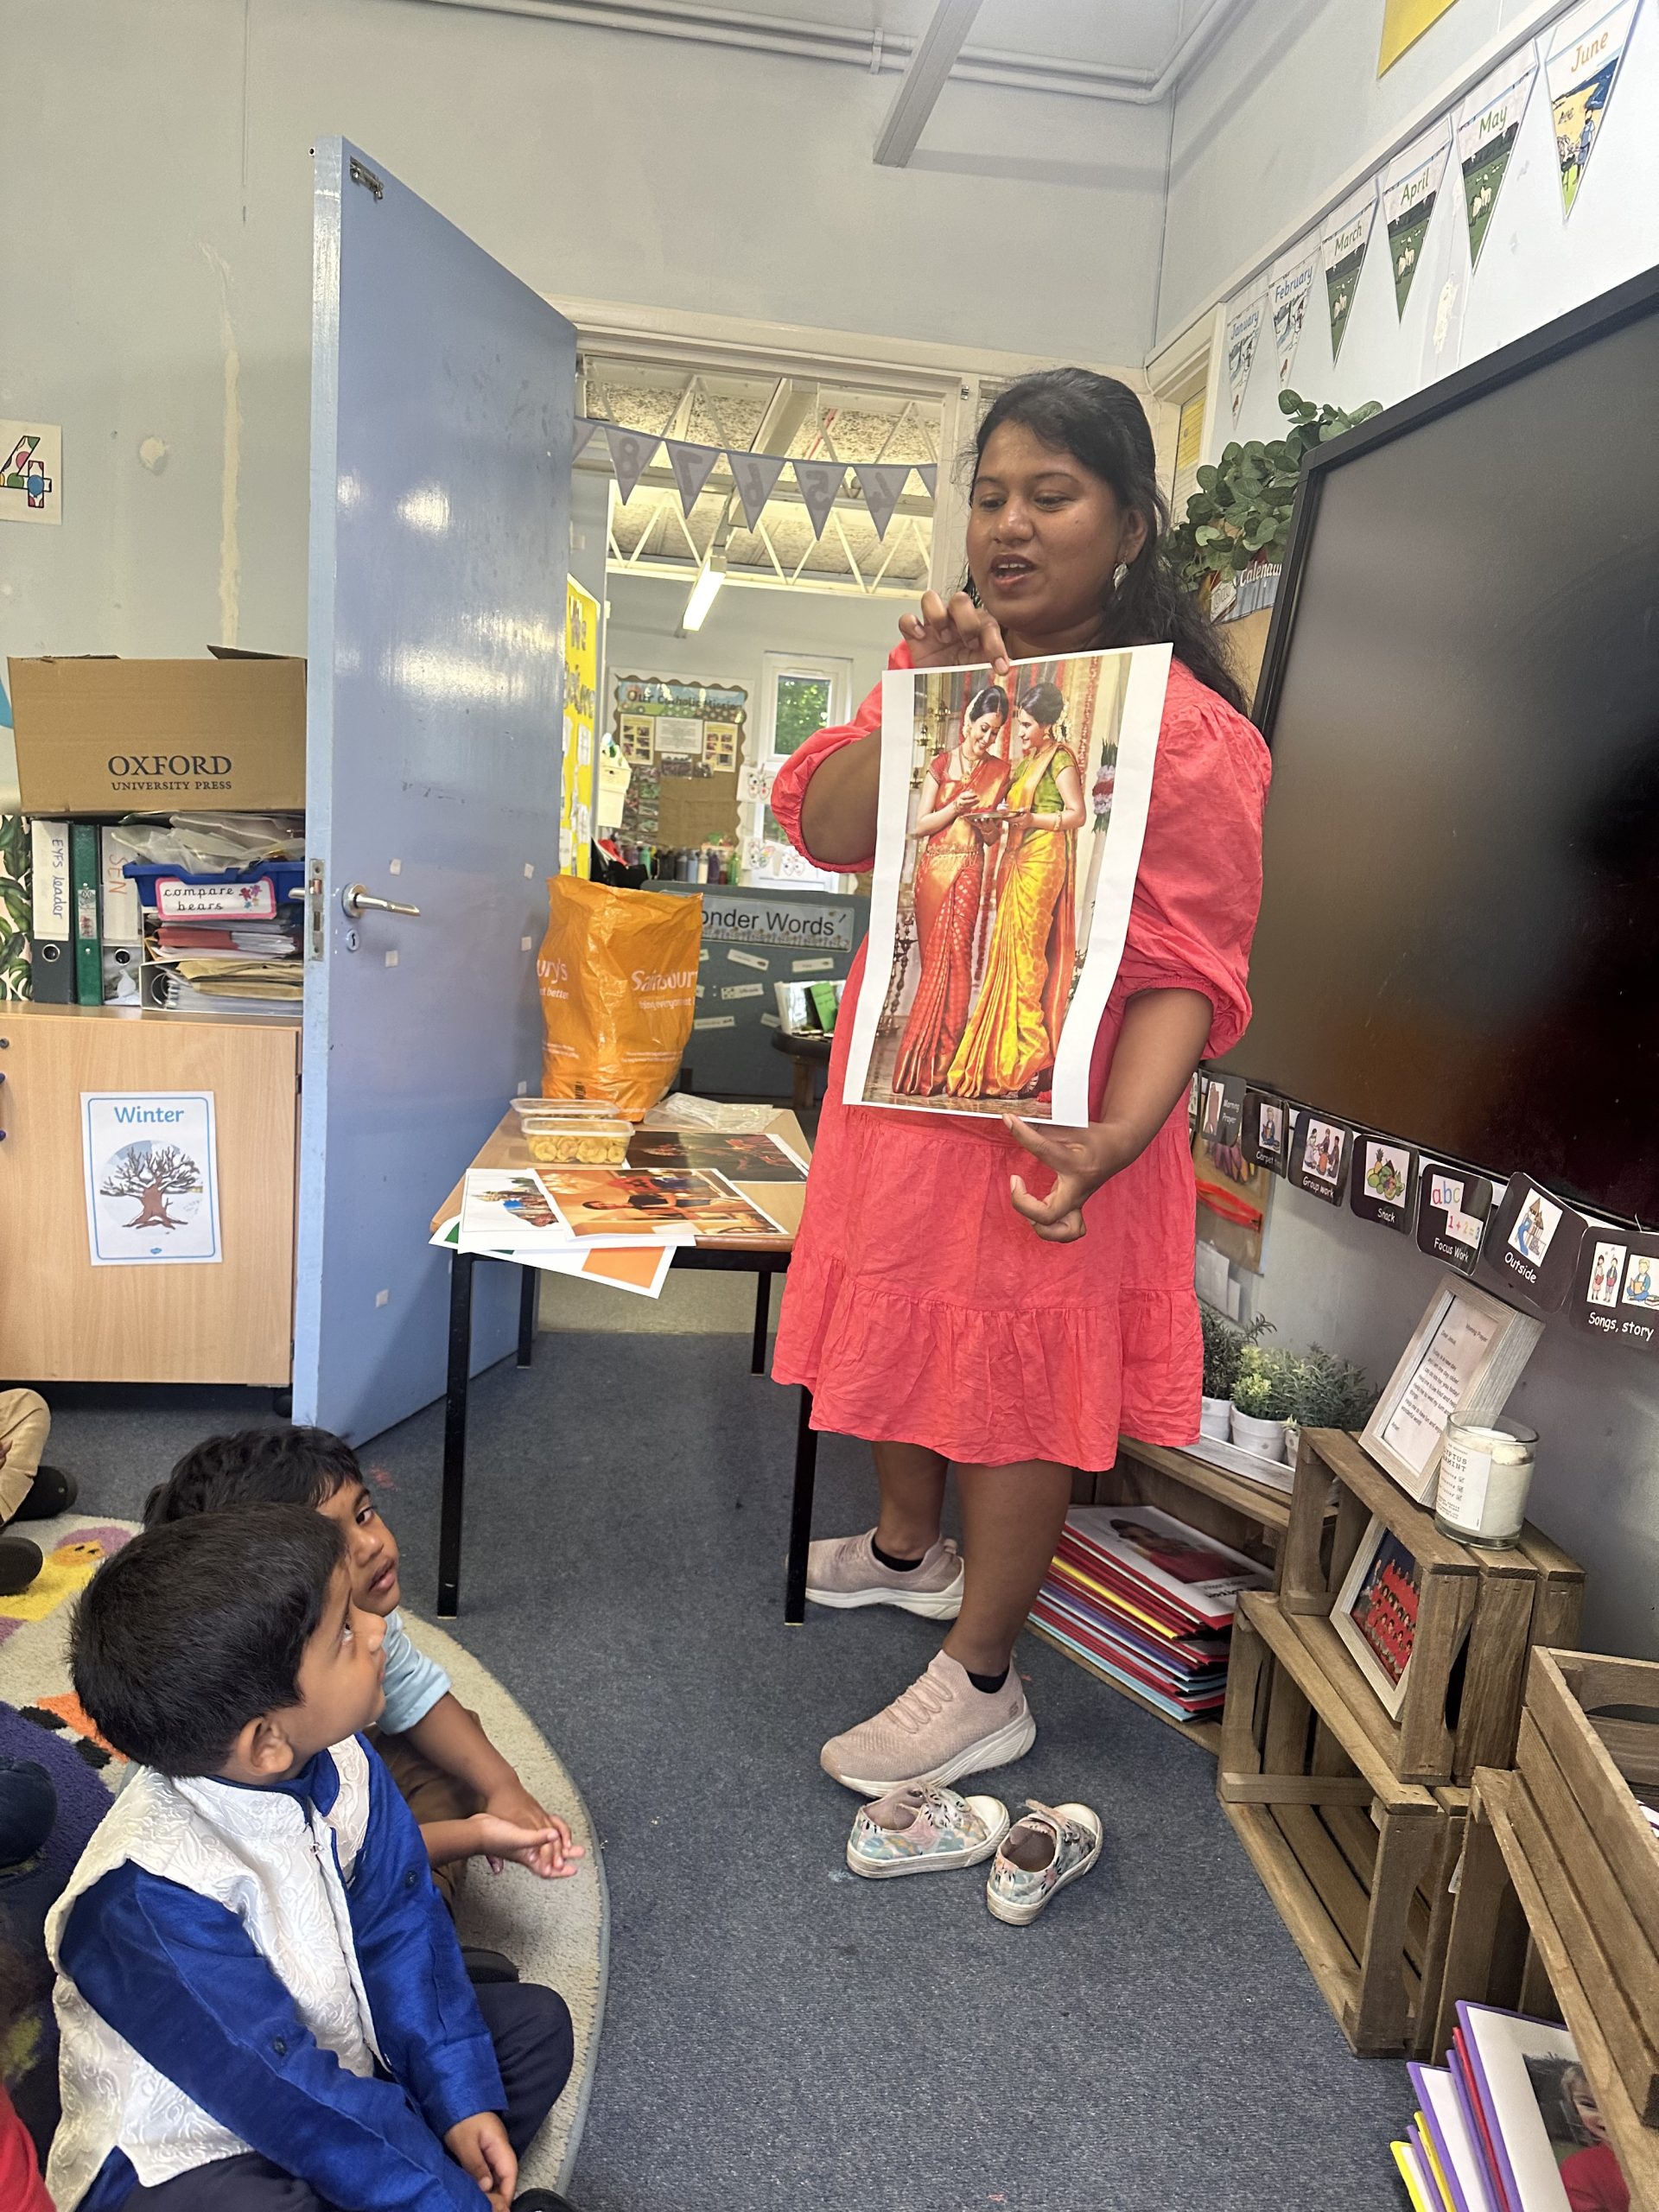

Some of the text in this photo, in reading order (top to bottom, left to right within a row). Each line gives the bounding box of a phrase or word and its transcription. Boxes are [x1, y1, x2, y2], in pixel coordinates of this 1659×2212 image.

[1571, 32, 1608, 73] June
[1479, 106, 1507, 139] May
[1401, 168, 1429, 206] April
[1335, 220, 1362, 256] March
[1275, 265, 1313, 302] February
[1231, 311, 1259, 340] January
[0, 435, 52, 508] 4
[107, 755, 232, 776] OXFORD
[111, 780, 232, 791] UNIVERSITY PRESS
[52, 839, 67, 920] EYFS leader
[107, 854, 129, 895] SEN
[163, 887, 235, 899] compare
[176, 900, 224, 912] bears
[702, 909, 835, 937] onder Words
[537, 958, 568, 984] ury's
[114, 1106, 184, 1123] Winter
[1302, 1176, 1334, 1198] Group work
[1432, 1180, 1461, 1205] abc
[1377, 1208, 1395, 1224] Snack
[1448, 1215, 1453, 1229] 1
[1434, 1237, 1469, 1263] Focus Work
[1504, 1252, 1537, 1284] Outside
[1588, 1312, 1655, 1341] Songs, story
